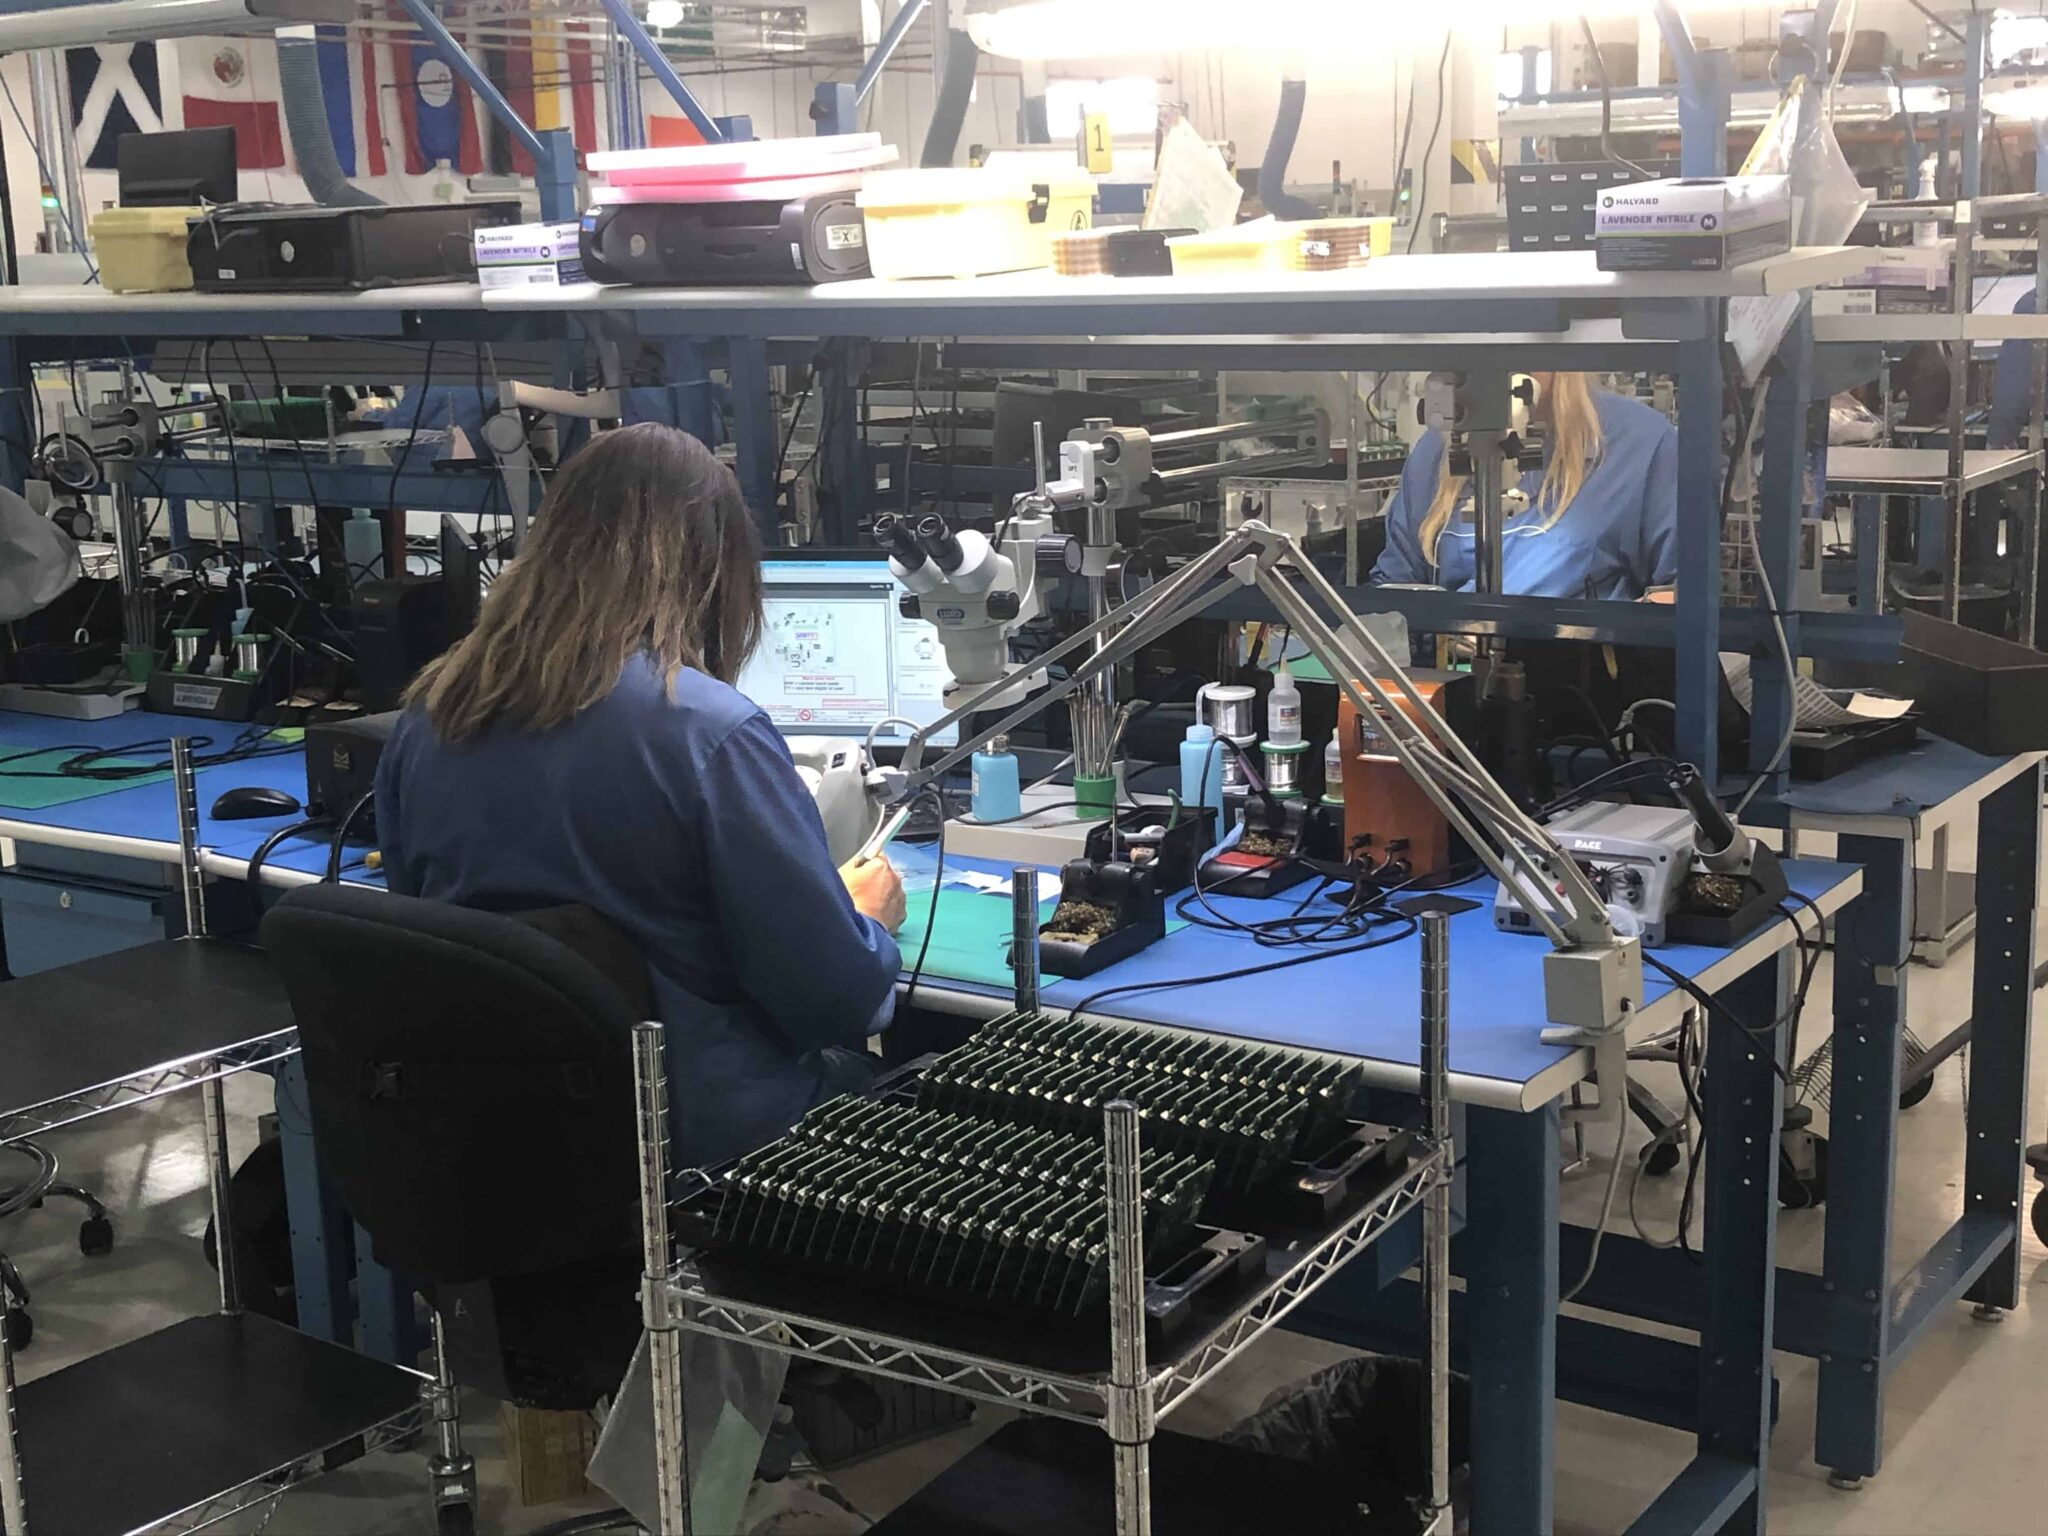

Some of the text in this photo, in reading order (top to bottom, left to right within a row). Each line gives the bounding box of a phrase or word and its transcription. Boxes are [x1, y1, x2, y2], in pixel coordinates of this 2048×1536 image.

[1094, 123, 1104, 152] 1
[1616, 197, 1659, 207] HALYARD
[1601, 215, 1652, 225] LAVENDER
[1656, 214, 1695, 224] NITRILE
[842, 231, 850, 243] X
[1574, 839, 1602, 850] PACE
